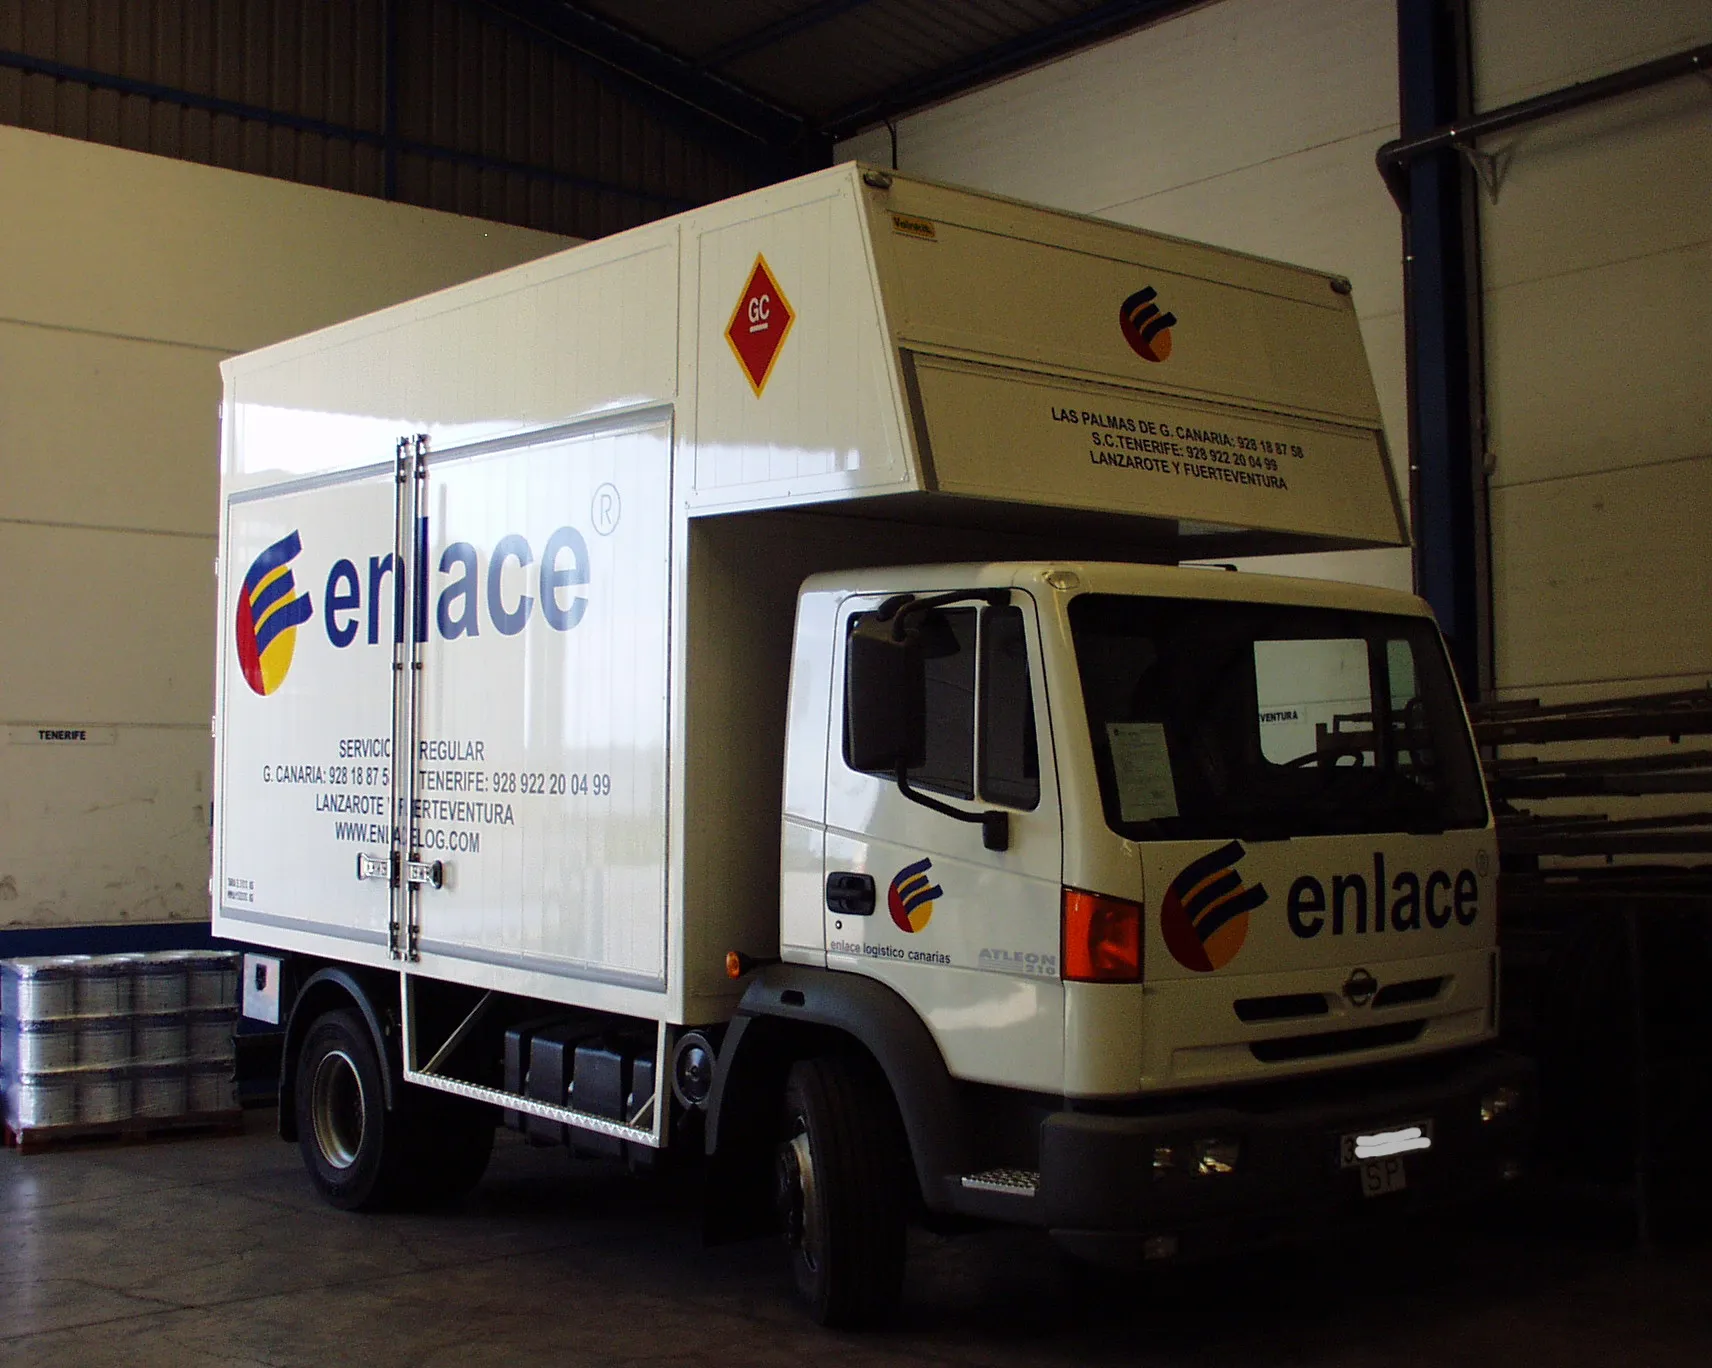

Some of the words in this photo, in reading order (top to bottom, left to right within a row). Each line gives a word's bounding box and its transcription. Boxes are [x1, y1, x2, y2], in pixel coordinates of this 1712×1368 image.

[748, 294, 770, 323] GC
[1051, 407, 1079, 424] LAS
[1081, 411, 1136, 432] PALMAS
[1139, 420, 1157, 435] DE
[1160, 423, 1174, 438] G.
[1177, 426, 1235, 448] CANARIA:
[1237, 435, 1257, 452] 928
[1260, 439, 1273, 454] 18
[1274, 441, 1287, 456] 87
[1092, 431, 1183, 457] S.C.TENERIFE:
[1186, 447, 1206, 461] 928
[1209, 449, 1231, 464] 922
[1233, 452, 1247, 466] 20
[1249, 454, 1262, 469] 04
[1264, 456, 1279, 471] 99
[1090, 450, 1170, 474] LANZAROTE
[1172, 462, 1181, 475] Y
[1184, 463, 1289, 491] FUERTEVENTURA
[324, 516, 591, 648] enlace
[38, 730, 86, 741] TENERIFE
[419, 740, 485, 761] REGULAR
[263, 765, 274, 782] G.
[276, 765, 326, 784] CANARIA:
[329, 766, 347, 784] 928
[351, 767, 363, 785] 18
[366, 767, 379, 786] 87
[419, 770, 488, 792] TENERIFE:
[493, 772, 516, 793] 928
[521, 773, 545, 794] 922
[549, 773, 566, 795] 20
[571, 774, 588, 795] 04
[593, 774, 611, 796] 99
[316, 793, 384, 815] LANZAROTE
[1287, 851, 1478, 939] enlace
[831, 940, 861, 953] enlace
[908, 949, 951, 964] canarias
[979, 948, 1056, 966] ATLEON
[1026, 965, 1056, 976] 210
[1367, 1159, 1398, 1190] SP
